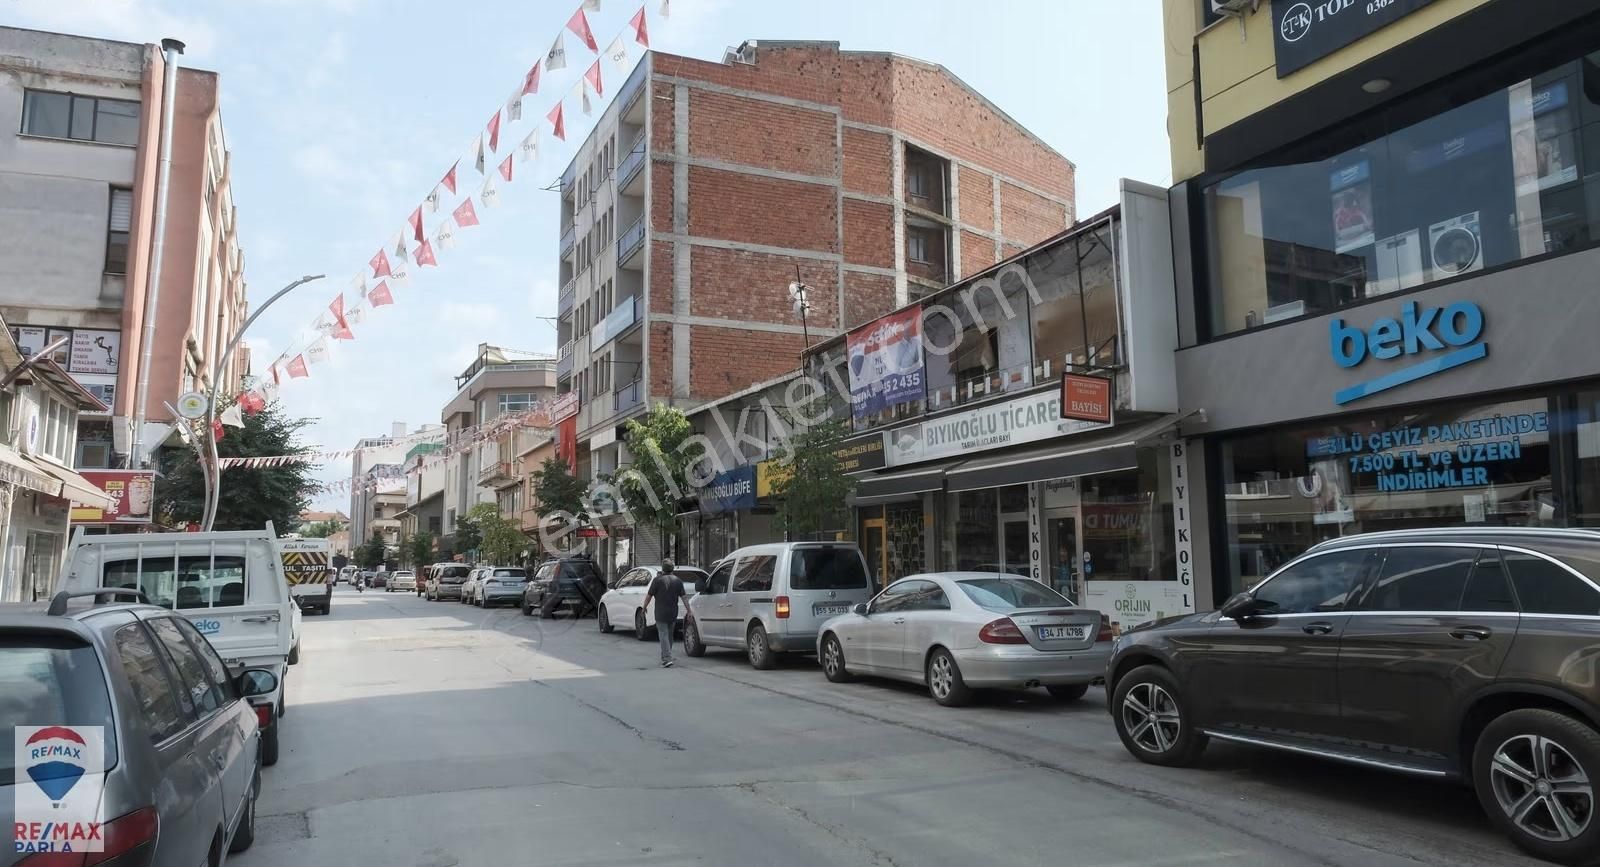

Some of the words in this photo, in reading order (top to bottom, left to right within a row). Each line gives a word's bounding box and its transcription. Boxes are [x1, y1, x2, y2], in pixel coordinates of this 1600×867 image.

[1330, 300, 1484, 369] beko
[900, 373, 920, 389] 435
[1071, 400, 1102, 414] BAYİSİ
[926, 413, 997, 447] BIYIKOĞLU
[1000, 399, 1060, 431] TİCARE
[1368, 425, 1424, 454] ÇEYİZ
[1427, 412, 1548, 443] PAKETİNDE
[1350, 453, 1394, 473] 7.500
[1401, 451, 1424, 469] TL
[1430, 451, 1452, 466] ve
[1458, 436, 1521, 464] ÜZERİ
[734, 479, 751, 496] BÜFE
[1376, 466, 1489, 492] İNDİRİMLER
[1173, 444, 1191, 608] BIYIKOĞL
[303, 565, 326, 573] TAŞITI
[195, 620, 220, 631] eko
[1044, 628, 1055, 637] 34
[1057, 628, 1064, 637] JT
[1066, 627, 1084, 637] 4788
